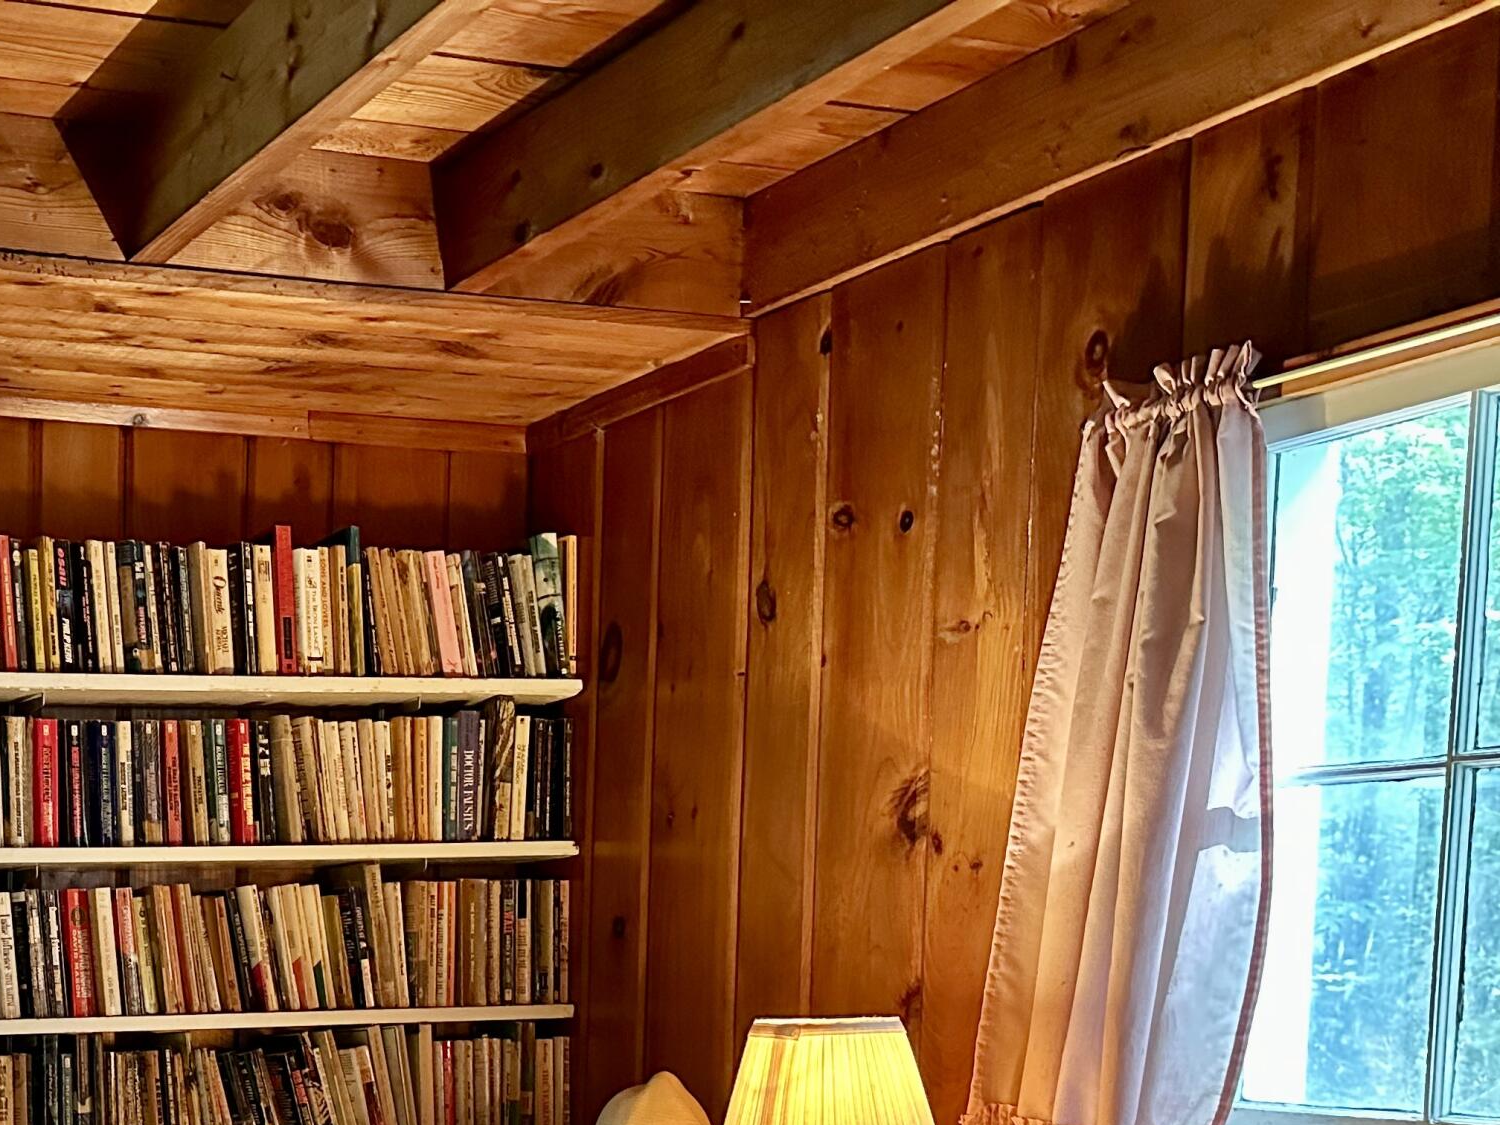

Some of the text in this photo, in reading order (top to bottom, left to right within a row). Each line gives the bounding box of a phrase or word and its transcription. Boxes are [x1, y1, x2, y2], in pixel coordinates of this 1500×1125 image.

[57, 548, 67, 587] esau
[62, 617, 73, 664] PHILIP KERR
[220, 625, 229, 654] MICHAEL
[556, 621, 565, 662] PATCHETT
[216, 746, 224, 769] ROBERT
[217, 770, 226, 794] LUDLUM
[463, 750, 475, 831] DOCTOR FAUSTUS
